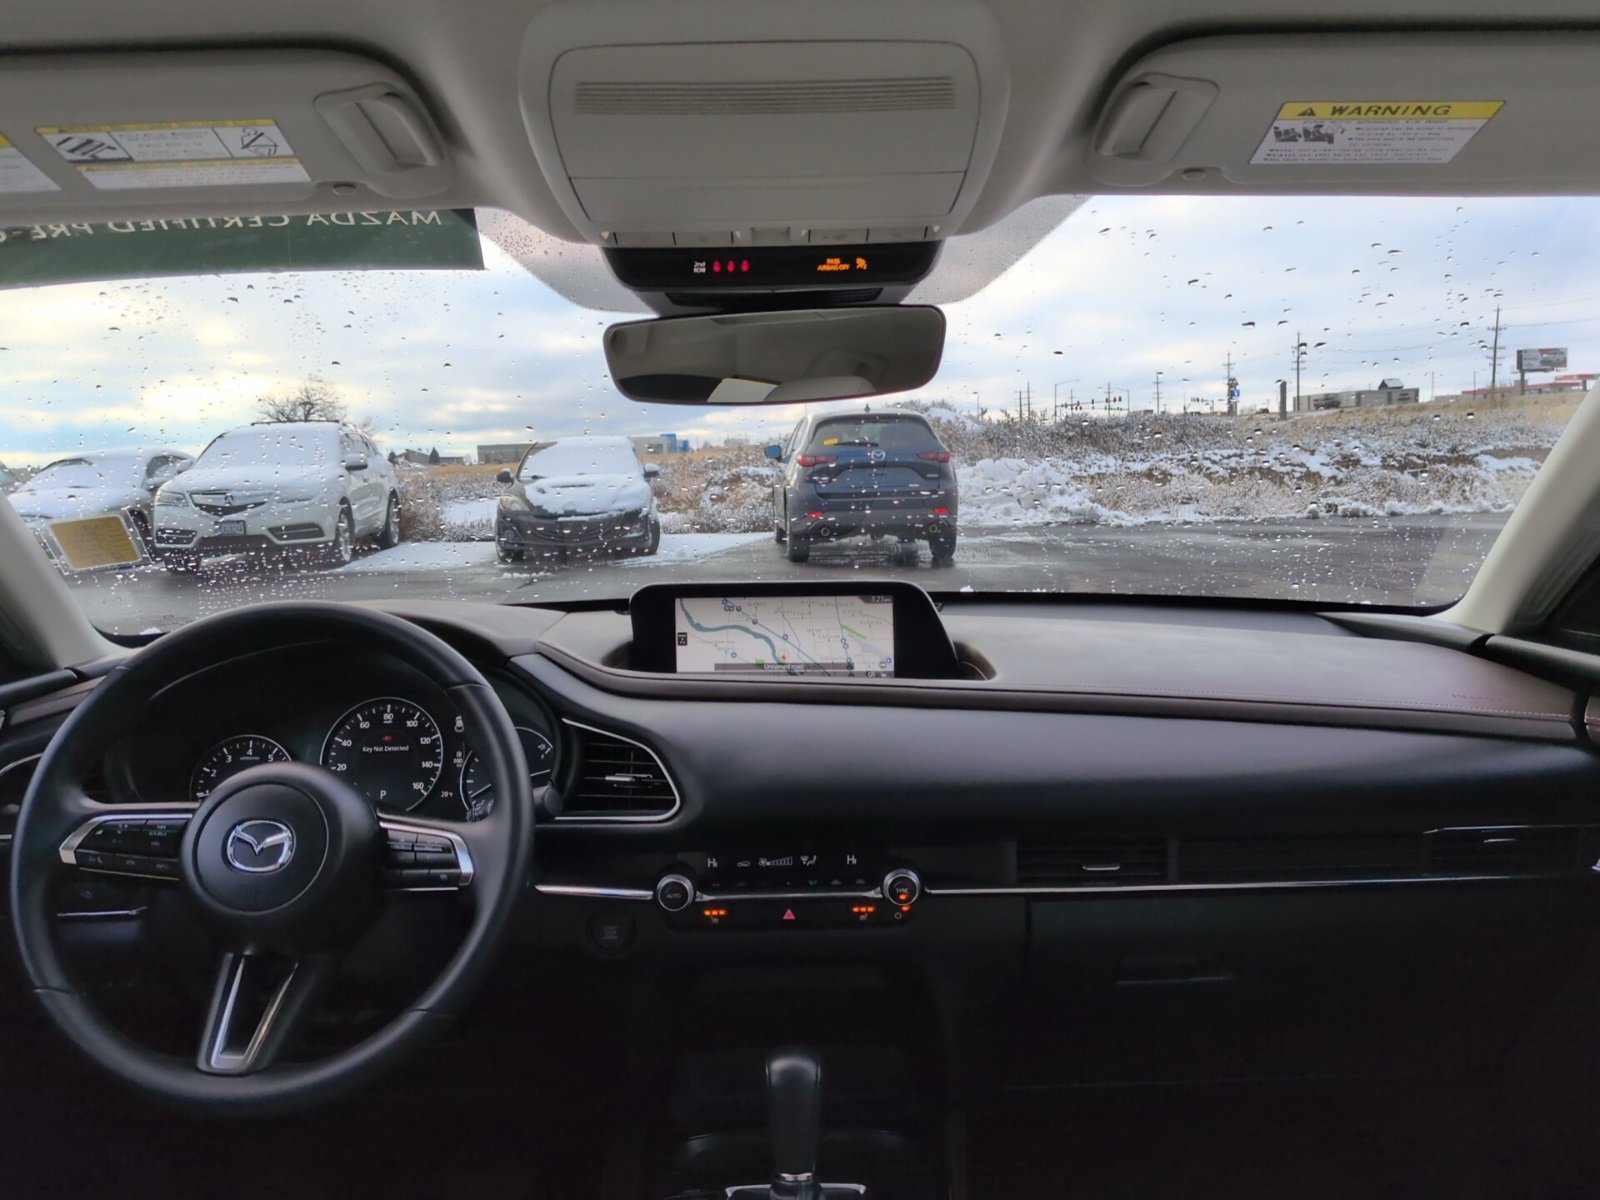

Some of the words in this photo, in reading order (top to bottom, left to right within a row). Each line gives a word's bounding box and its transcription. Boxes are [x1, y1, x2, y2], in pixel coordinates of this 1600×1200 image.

[1330, 105, 1452, 116] WARNING
[406, 720, 418, 728] 100
[246, 748, 252, 756] 4
[226, 755, 232, 763] 3
[268, 754, 274, 762] 5
[336, 763, 347, 771] 20
[421, 761, 433, 769] 140
[210, 769, 217, 777] 2
[412, 782, 424, 790] 160
[380, 790, 387, 800] P
